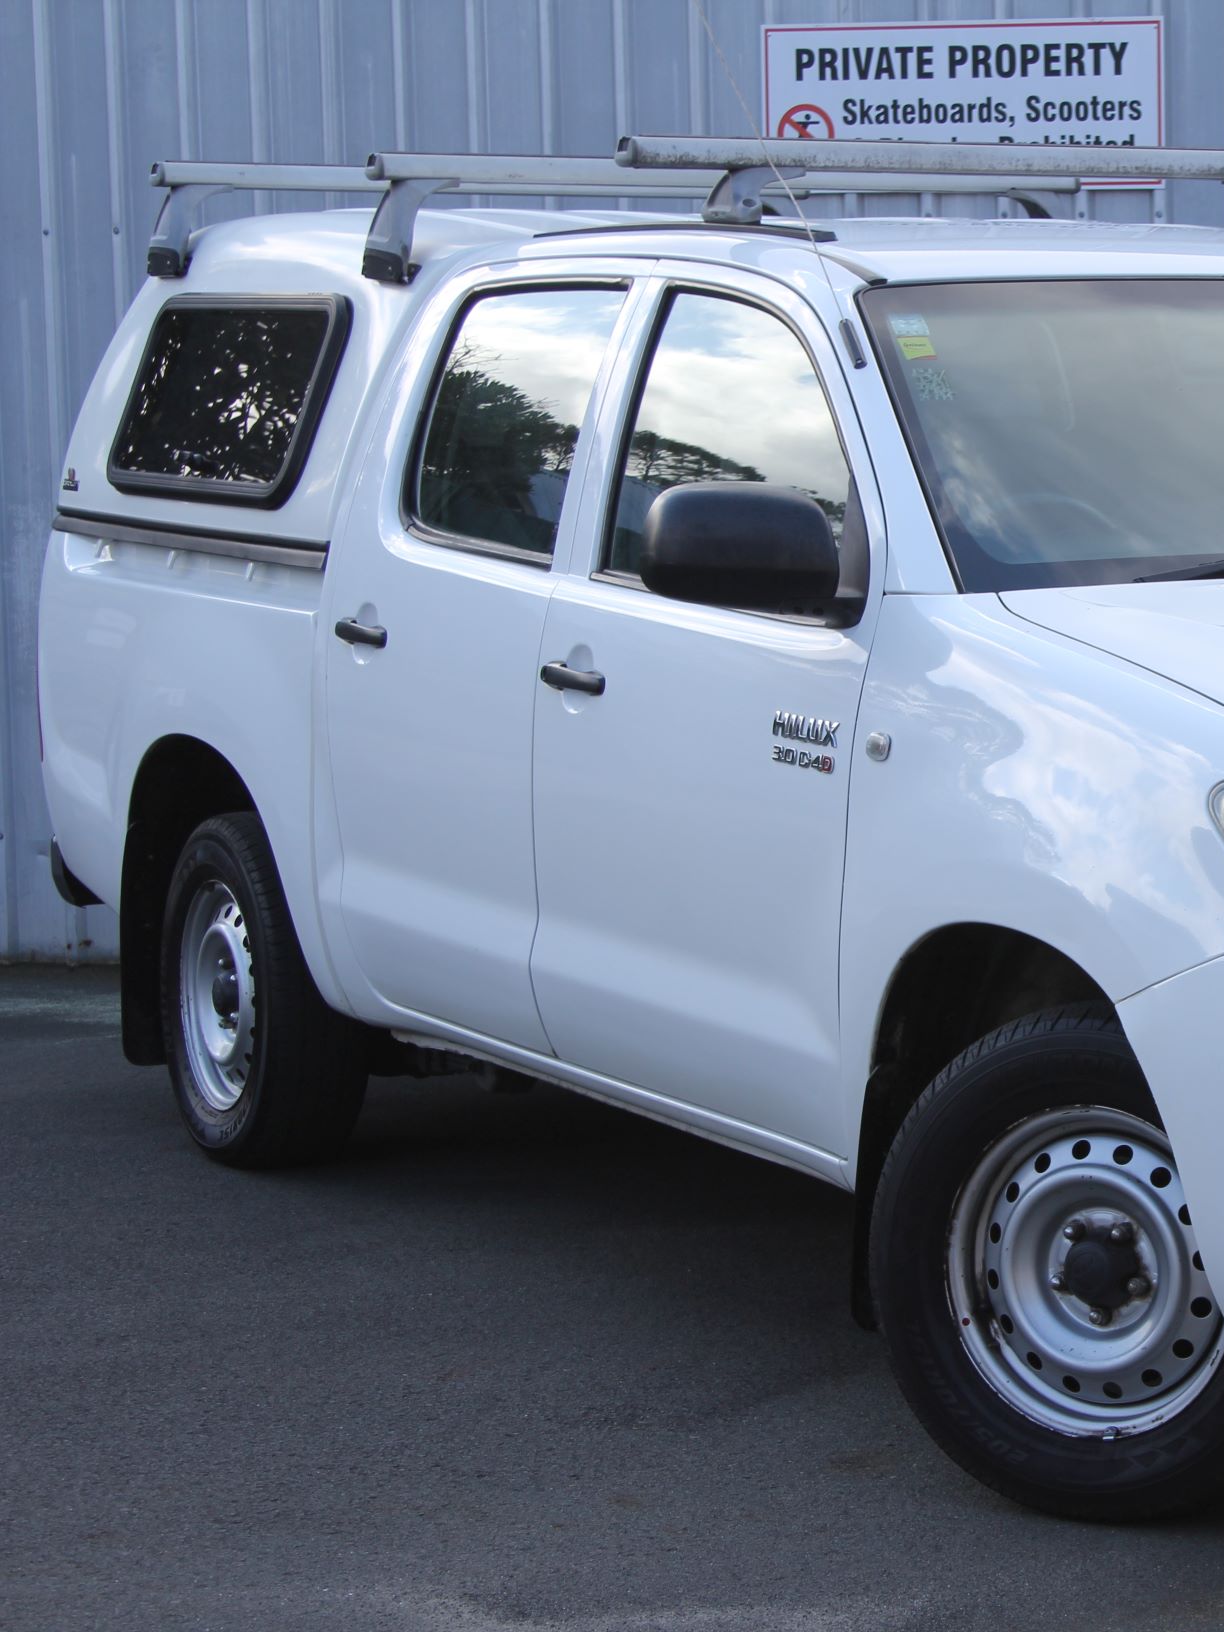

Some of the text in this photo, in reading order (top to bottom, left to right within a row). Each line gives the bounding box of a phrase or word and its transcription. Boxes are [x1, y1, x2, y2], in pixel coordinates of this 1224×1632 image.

[795, 42, 1129, 81] PRIVATE PROPERTY
[842, 94, 1142, 128] Skateboards, Scooters
[772, 711, 840, 748] HILUX
